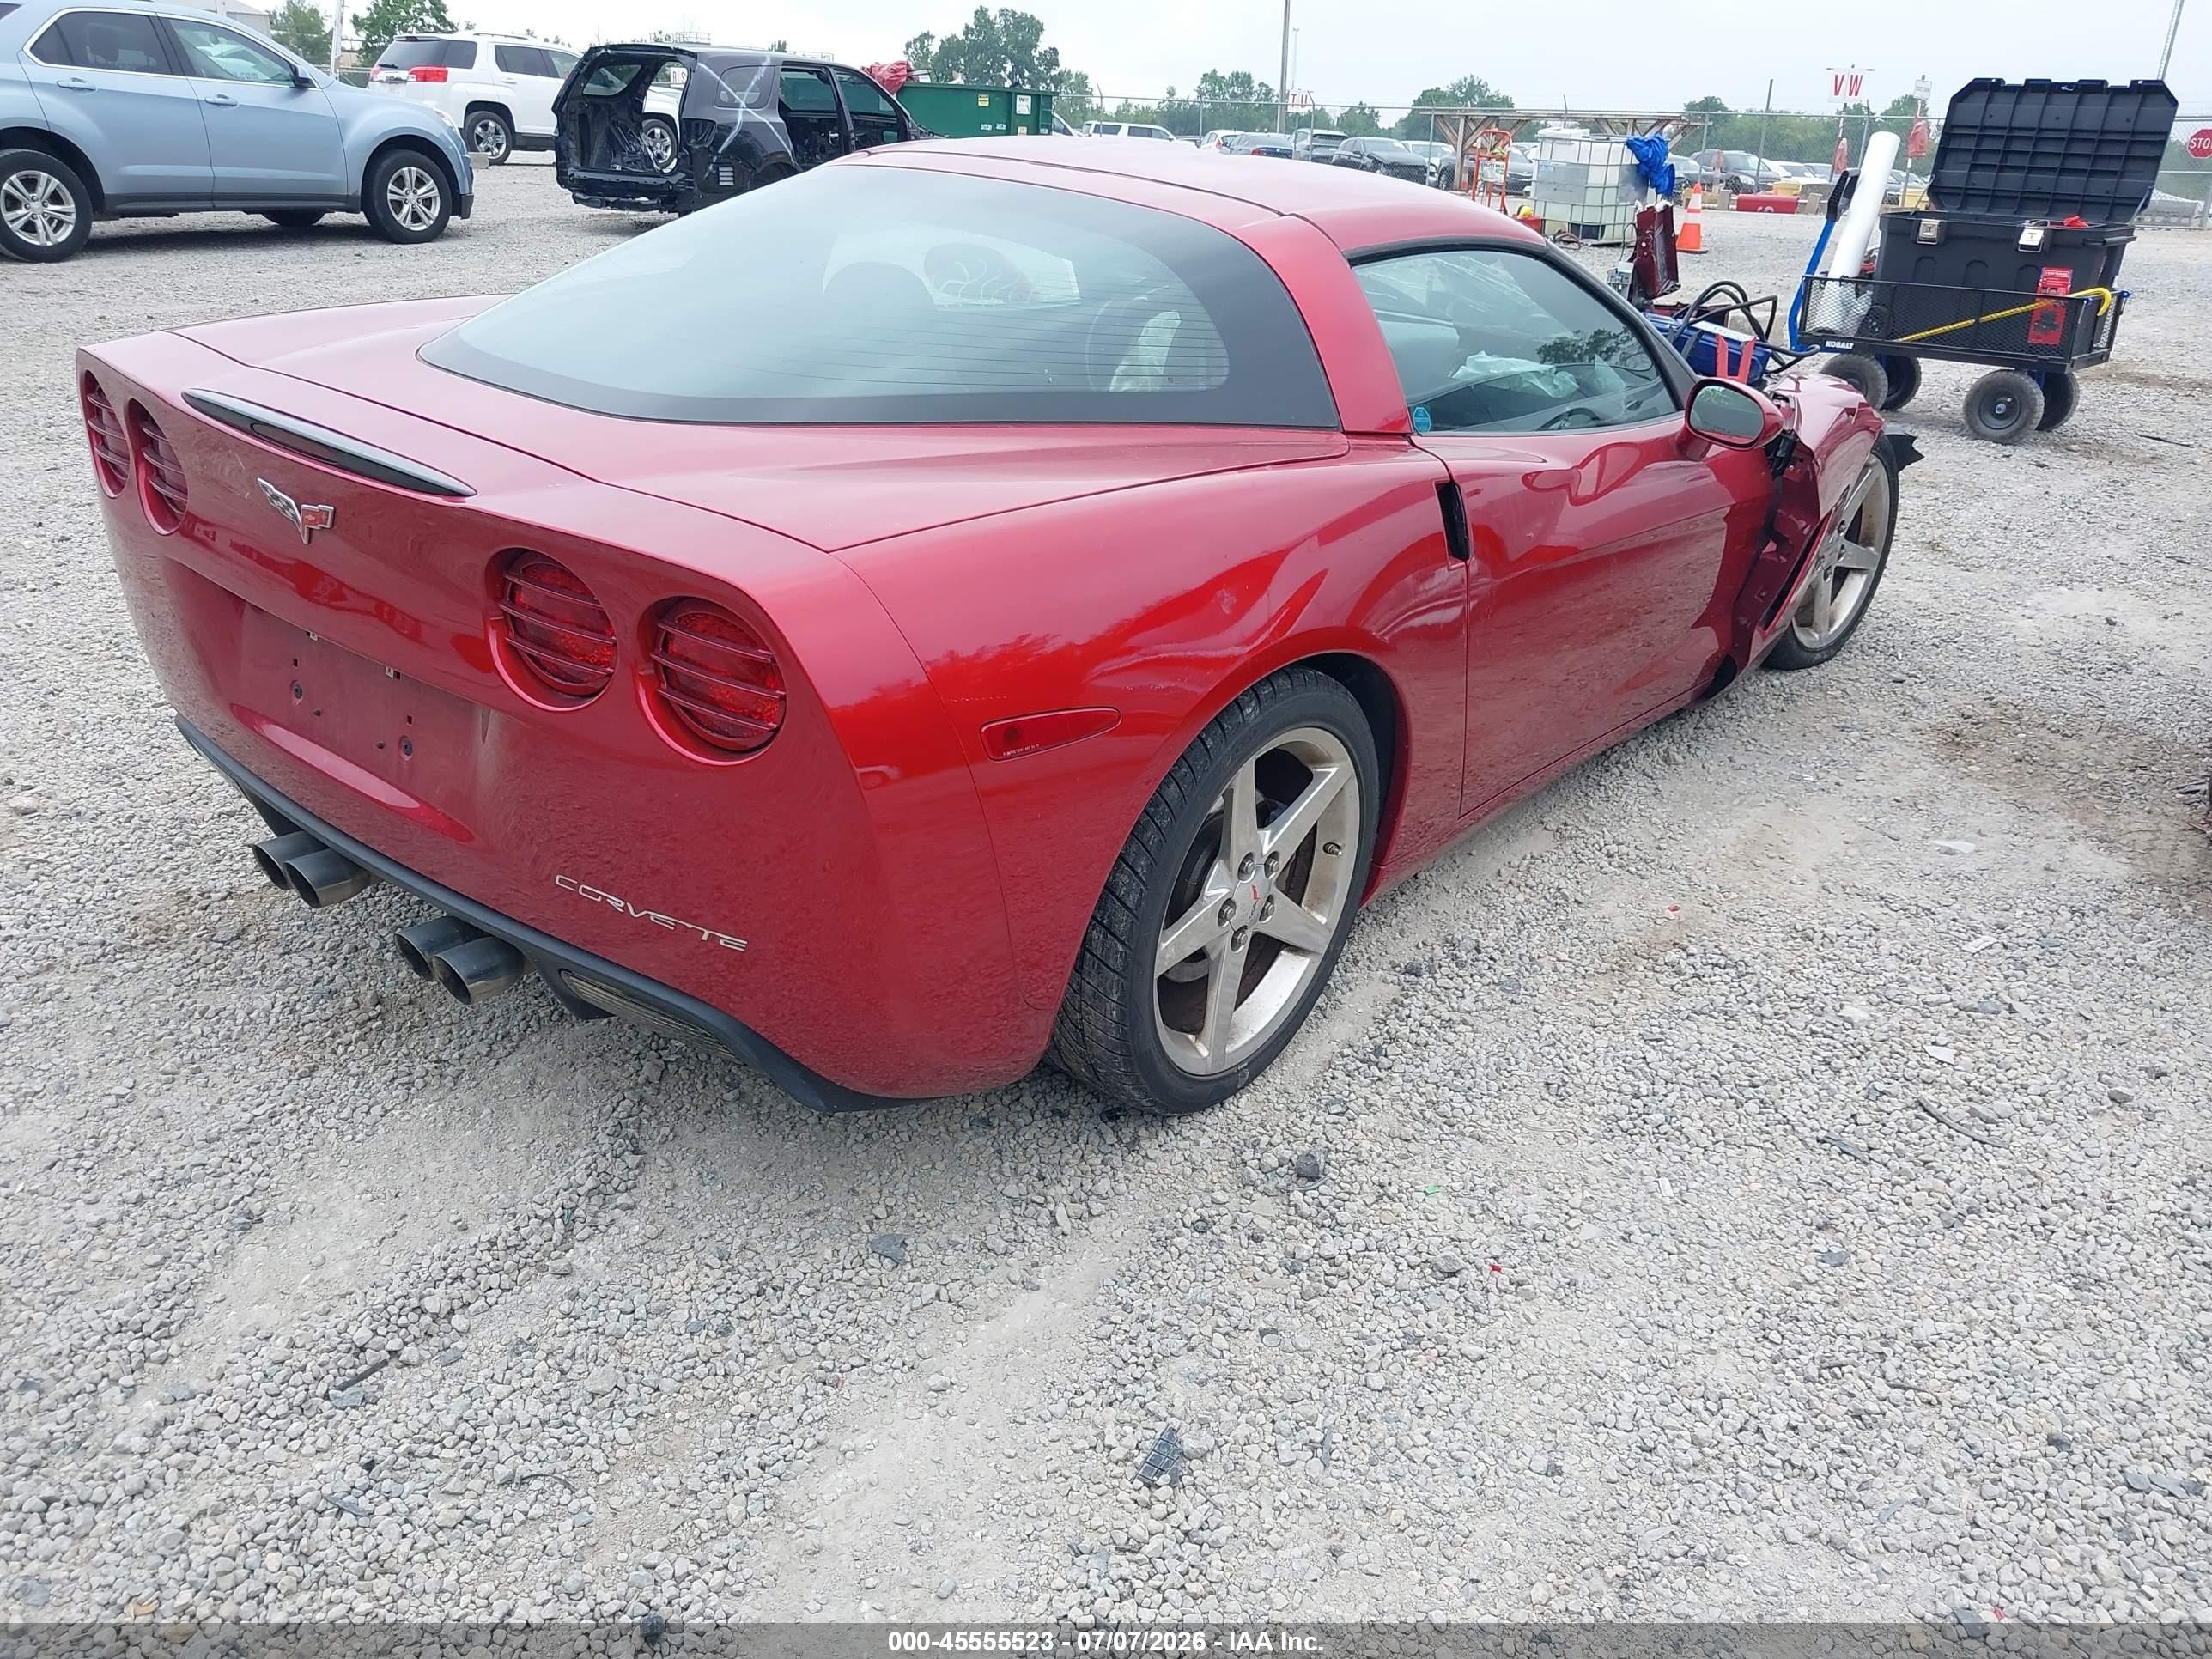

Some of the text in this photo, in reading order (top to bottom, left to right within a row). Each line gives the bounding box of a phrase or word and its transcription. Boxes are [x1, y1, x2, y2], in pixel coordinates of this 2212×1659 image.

[2190, 137, 2212, 149] STO
[1826, 340, 1855, 349] KOBALT
[555, 874, 748, 952] CORVETTE
